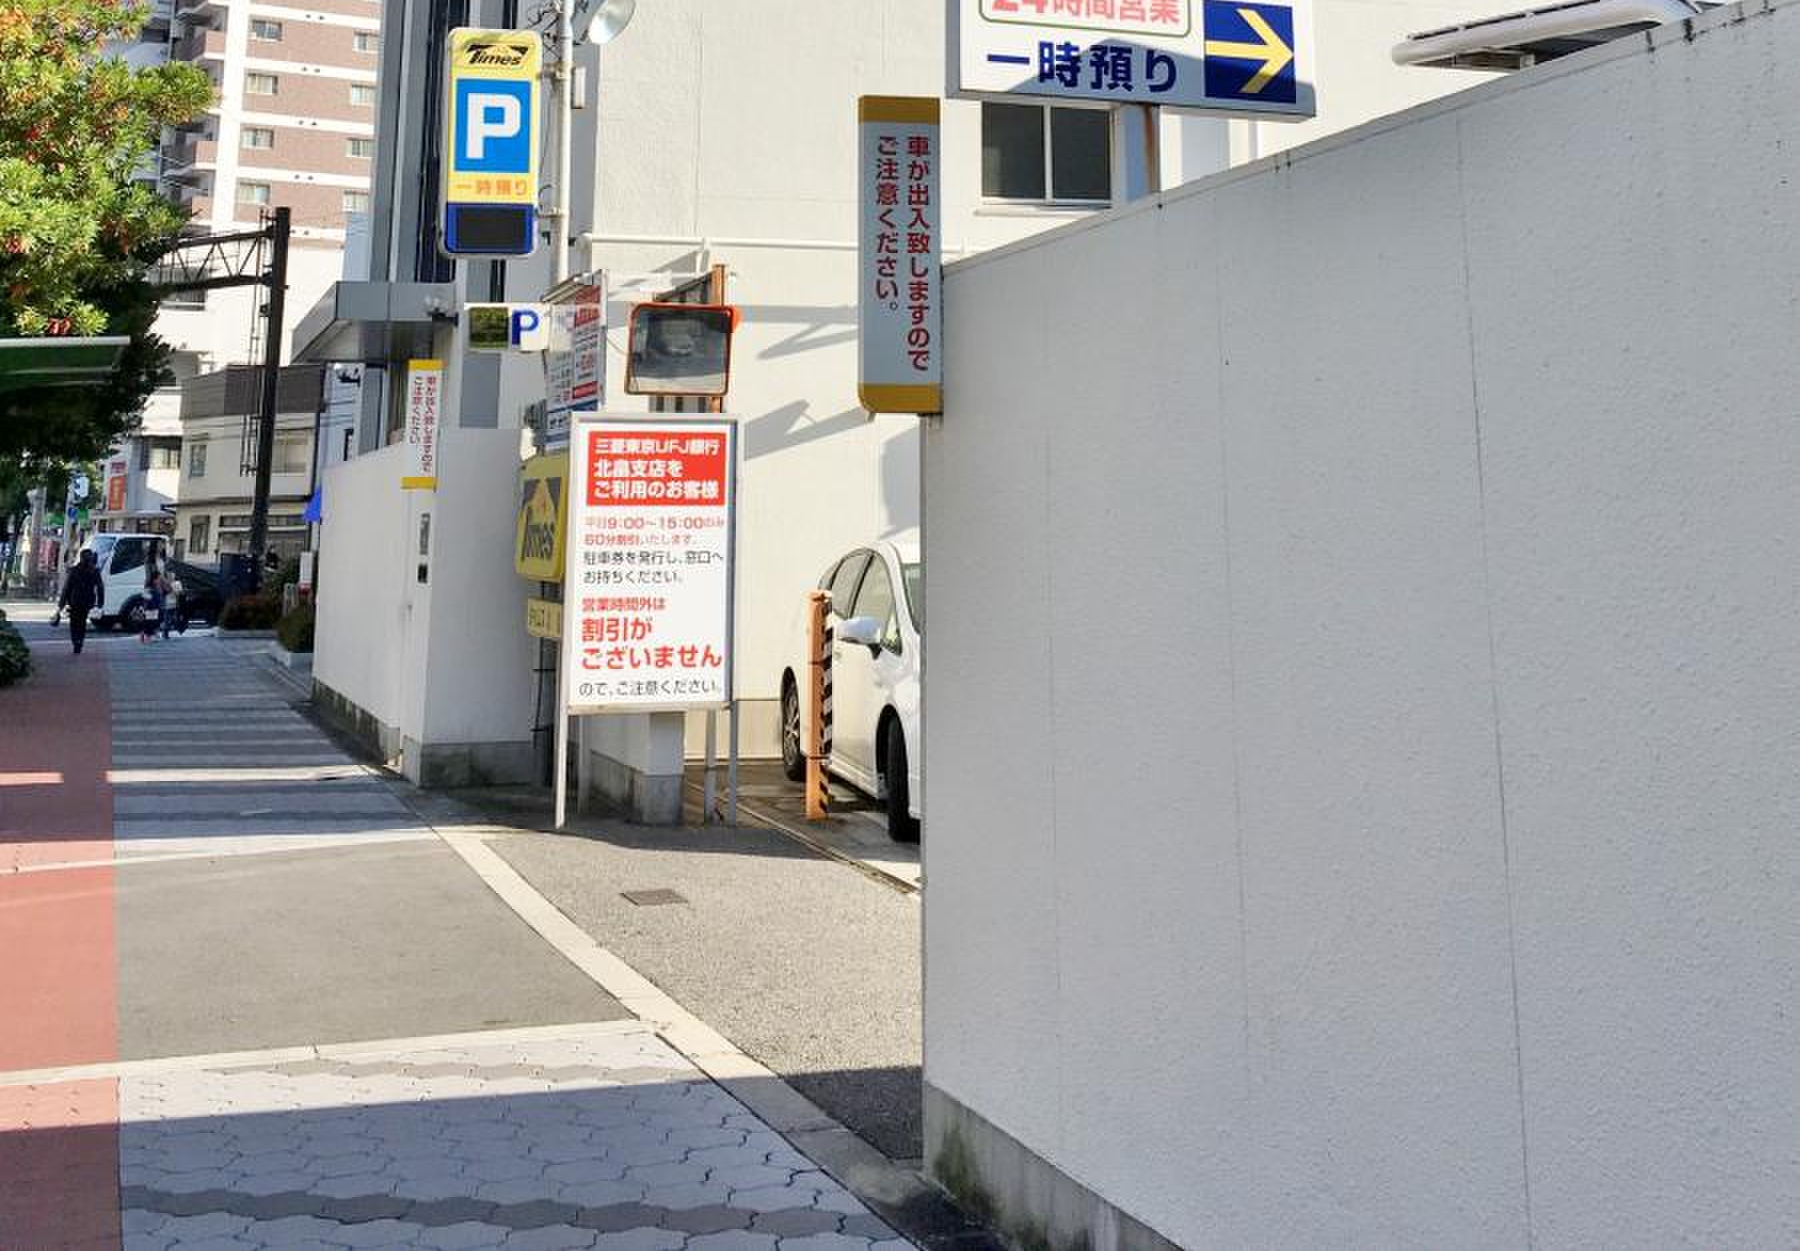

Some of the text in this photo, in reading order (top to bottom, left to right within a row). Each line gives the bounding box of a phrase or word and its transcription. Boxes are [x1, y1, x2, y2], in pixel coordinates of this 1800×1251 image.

[467, 46, 526, 66] Times
[986, 39, 1178, 93] 一時預り
[466, 92, 522, 160] P
[906, 135, 931, 372] 車が出入致しますので
[511, 309, 539, 346] P
[594, 480, 719, 500] ご利用のお客様
[581, 616, 654, 642] 割引が
[581, 644, 723, 670] ございません
